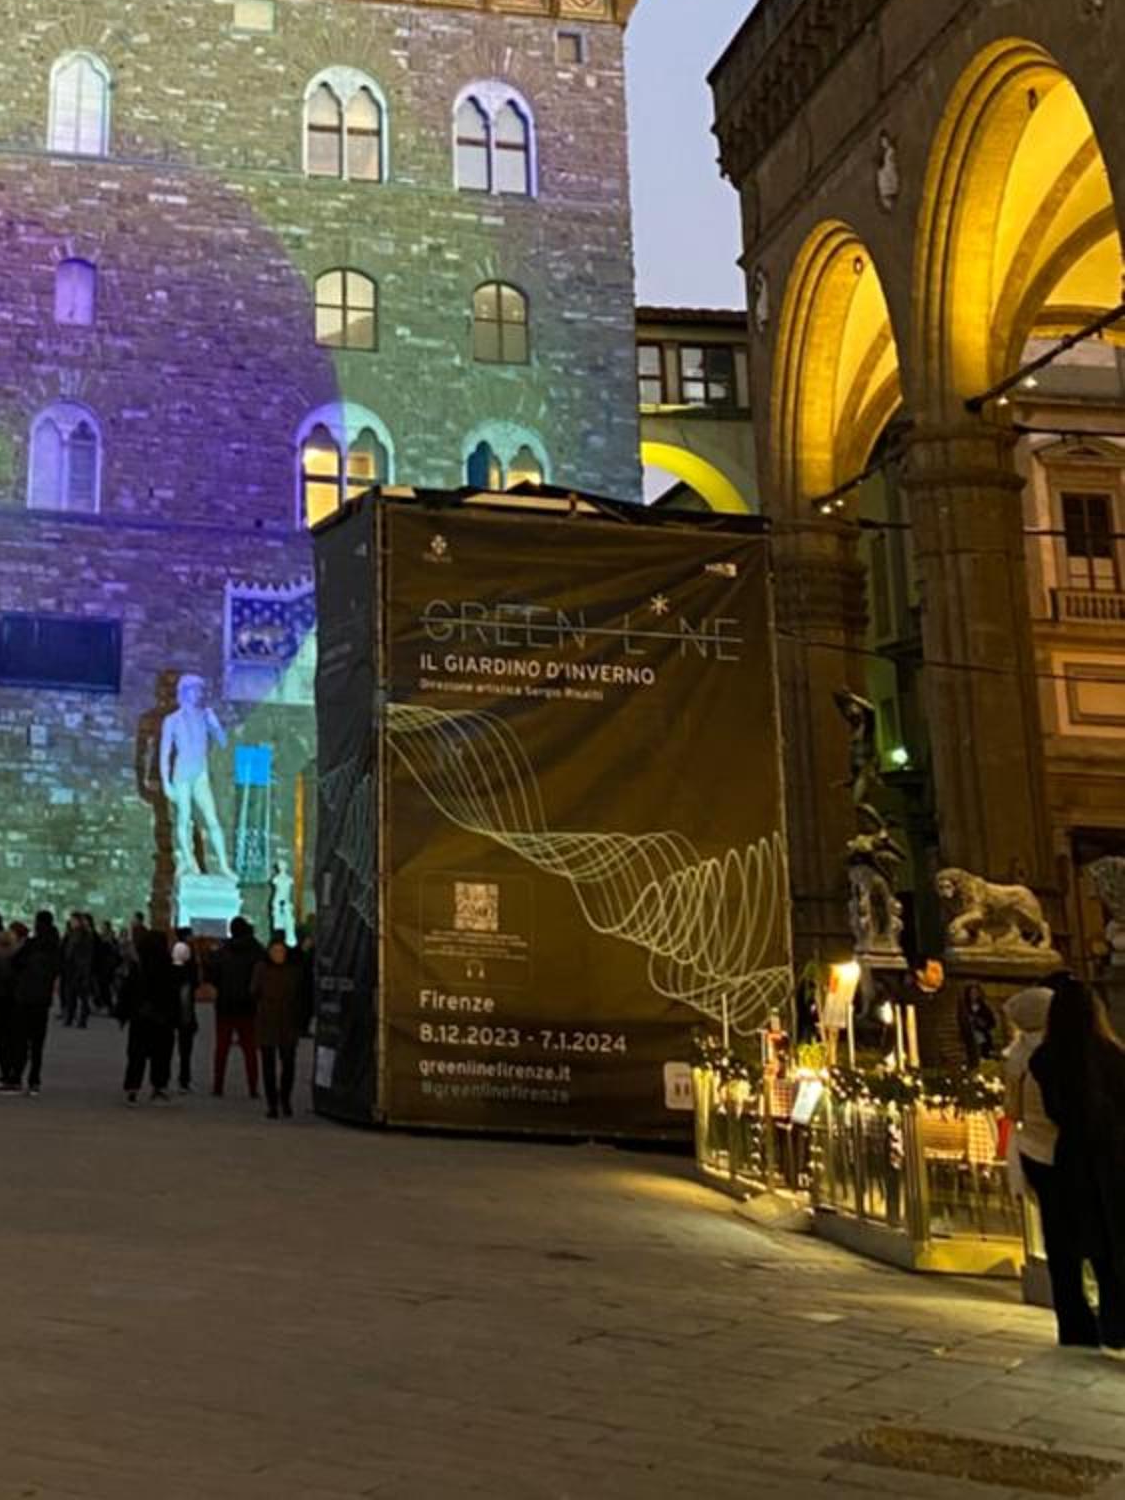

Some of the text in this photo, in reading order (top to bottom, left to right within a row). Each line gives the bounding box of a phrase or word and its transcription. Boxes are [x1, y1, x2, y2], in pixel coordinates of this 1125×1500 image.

[423, 598, 587, 650] GREEN
[419, 652, 656, 686] IL GIARDINO D'INVERNO
[419, 989, 495, 1013] Firenze
[419, 1023, 521, 1048] 8.12.2023
[539, 1030, 628, 1054] 7.1.2024
[418, 1059, 572, 1083] greenlinefirenze.it
